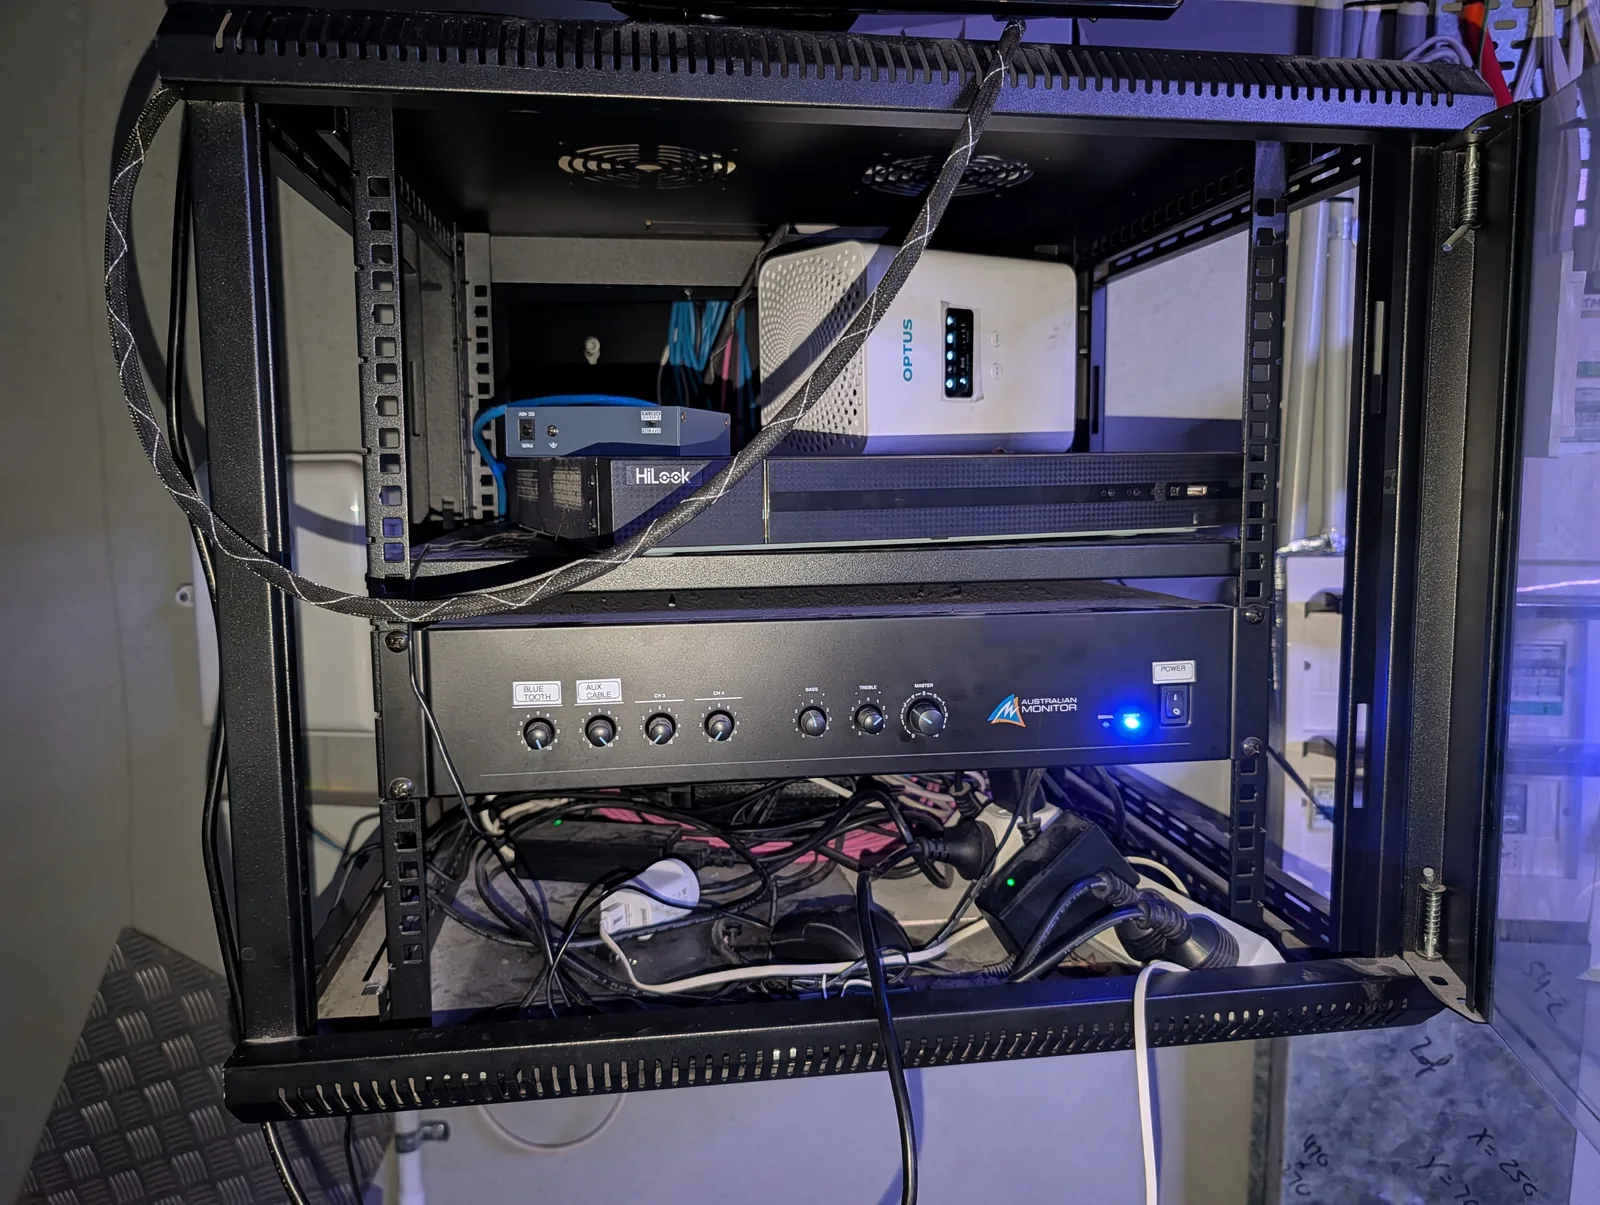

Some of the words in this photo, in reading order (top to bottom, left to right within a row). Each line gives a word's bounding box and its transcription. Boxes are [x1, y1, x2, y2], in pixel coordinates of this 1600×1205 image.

[902, 318, 912, 382] OPTUS
[636, 468, 691, 484] HiLook
[586, 691, 612, 699] CABLE
[1022, 704, 1077, 712] MONITOR
